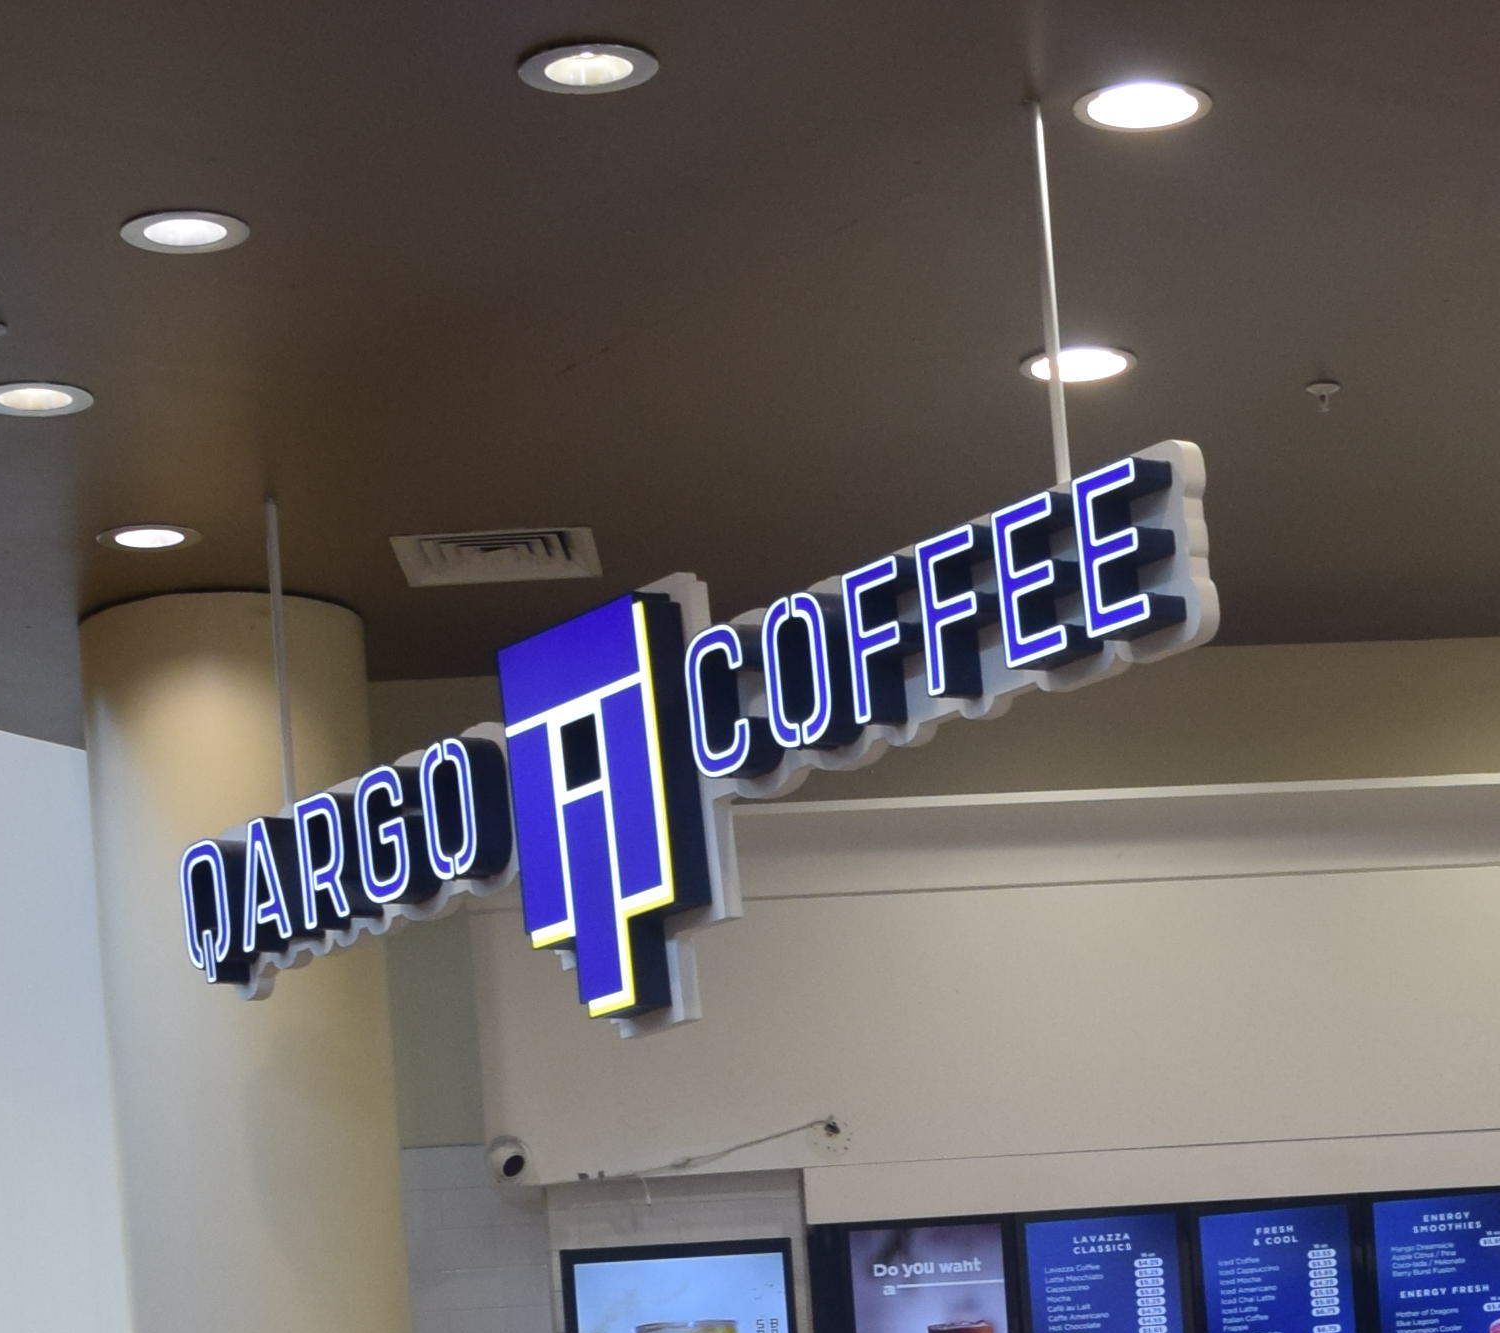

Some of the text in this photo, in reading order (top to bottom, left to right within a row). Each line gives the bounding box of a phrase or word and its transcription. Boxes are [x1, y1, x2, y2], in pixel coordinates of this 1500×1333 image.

[685, 456, 1152, 780] COFFEE
[178, 736, 480, 983] QARGO
[1423, 1211, 1470, 1222] ENERGY
[1256, 1225, 1294, 1235] FRESH
[1413, 1221, 1482, 1233] SMOOTHIES
[1073, 1233, 1130, 1244] LAVAZZA
[1265, 1236, 1298, 1245] COOL
[1073, 1243, 1132, 1255] CLASSICS
[873, 1263, 899, 1277] Do
[902, 1261, 934, 1278] you
[883, 1285, 896, 1296] a
[1400, 1284, 1490, 1298] ENERGY FRESH
